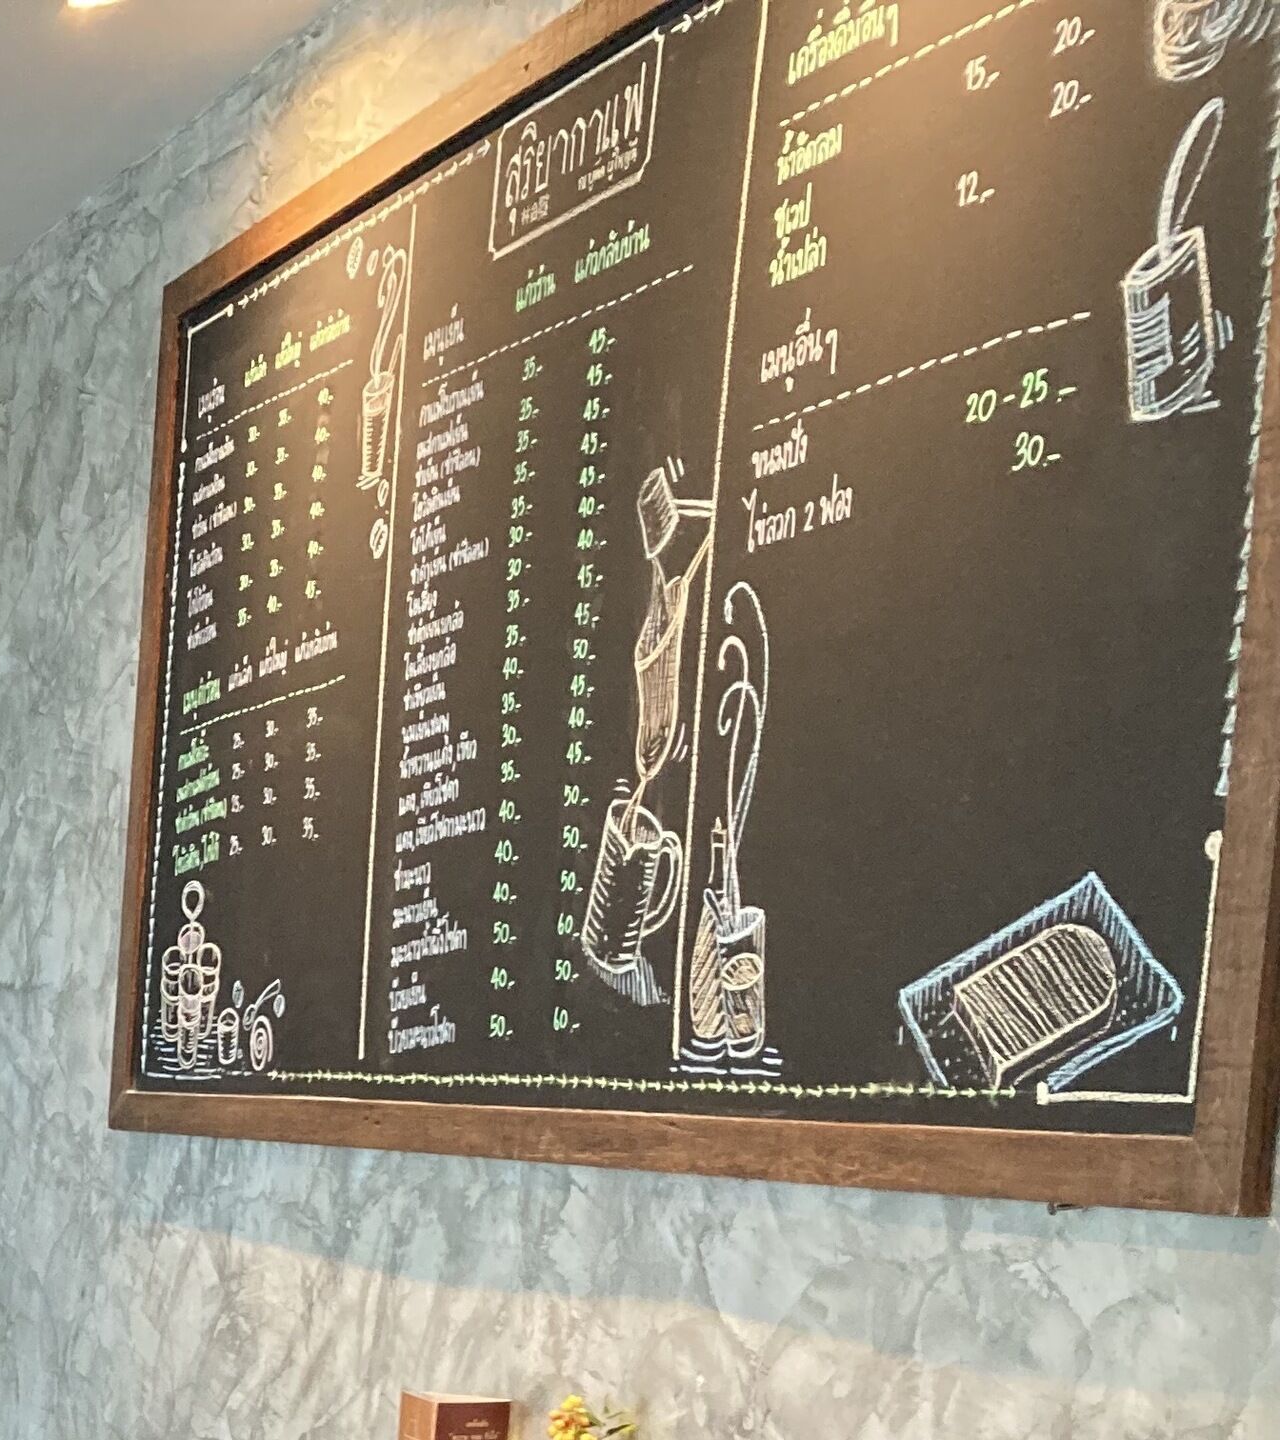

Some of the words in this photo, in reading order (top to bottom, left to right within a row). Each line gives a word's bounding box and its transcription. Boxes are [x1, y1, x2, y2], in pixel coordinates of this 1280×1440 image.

[505, 61, 647, 236] สุริยากาแฟ
[776, 123, 843, 186] น้ำอัดลม
[769, 226, 827, 288] น้ำเปล่า
[752, 418, 808, 479] ขนมปัง
[741, 489, 796, 553] ไข่ลวก
[803, 501, 815, 532] 2
[820, 473, 853, 526] ฟอง
